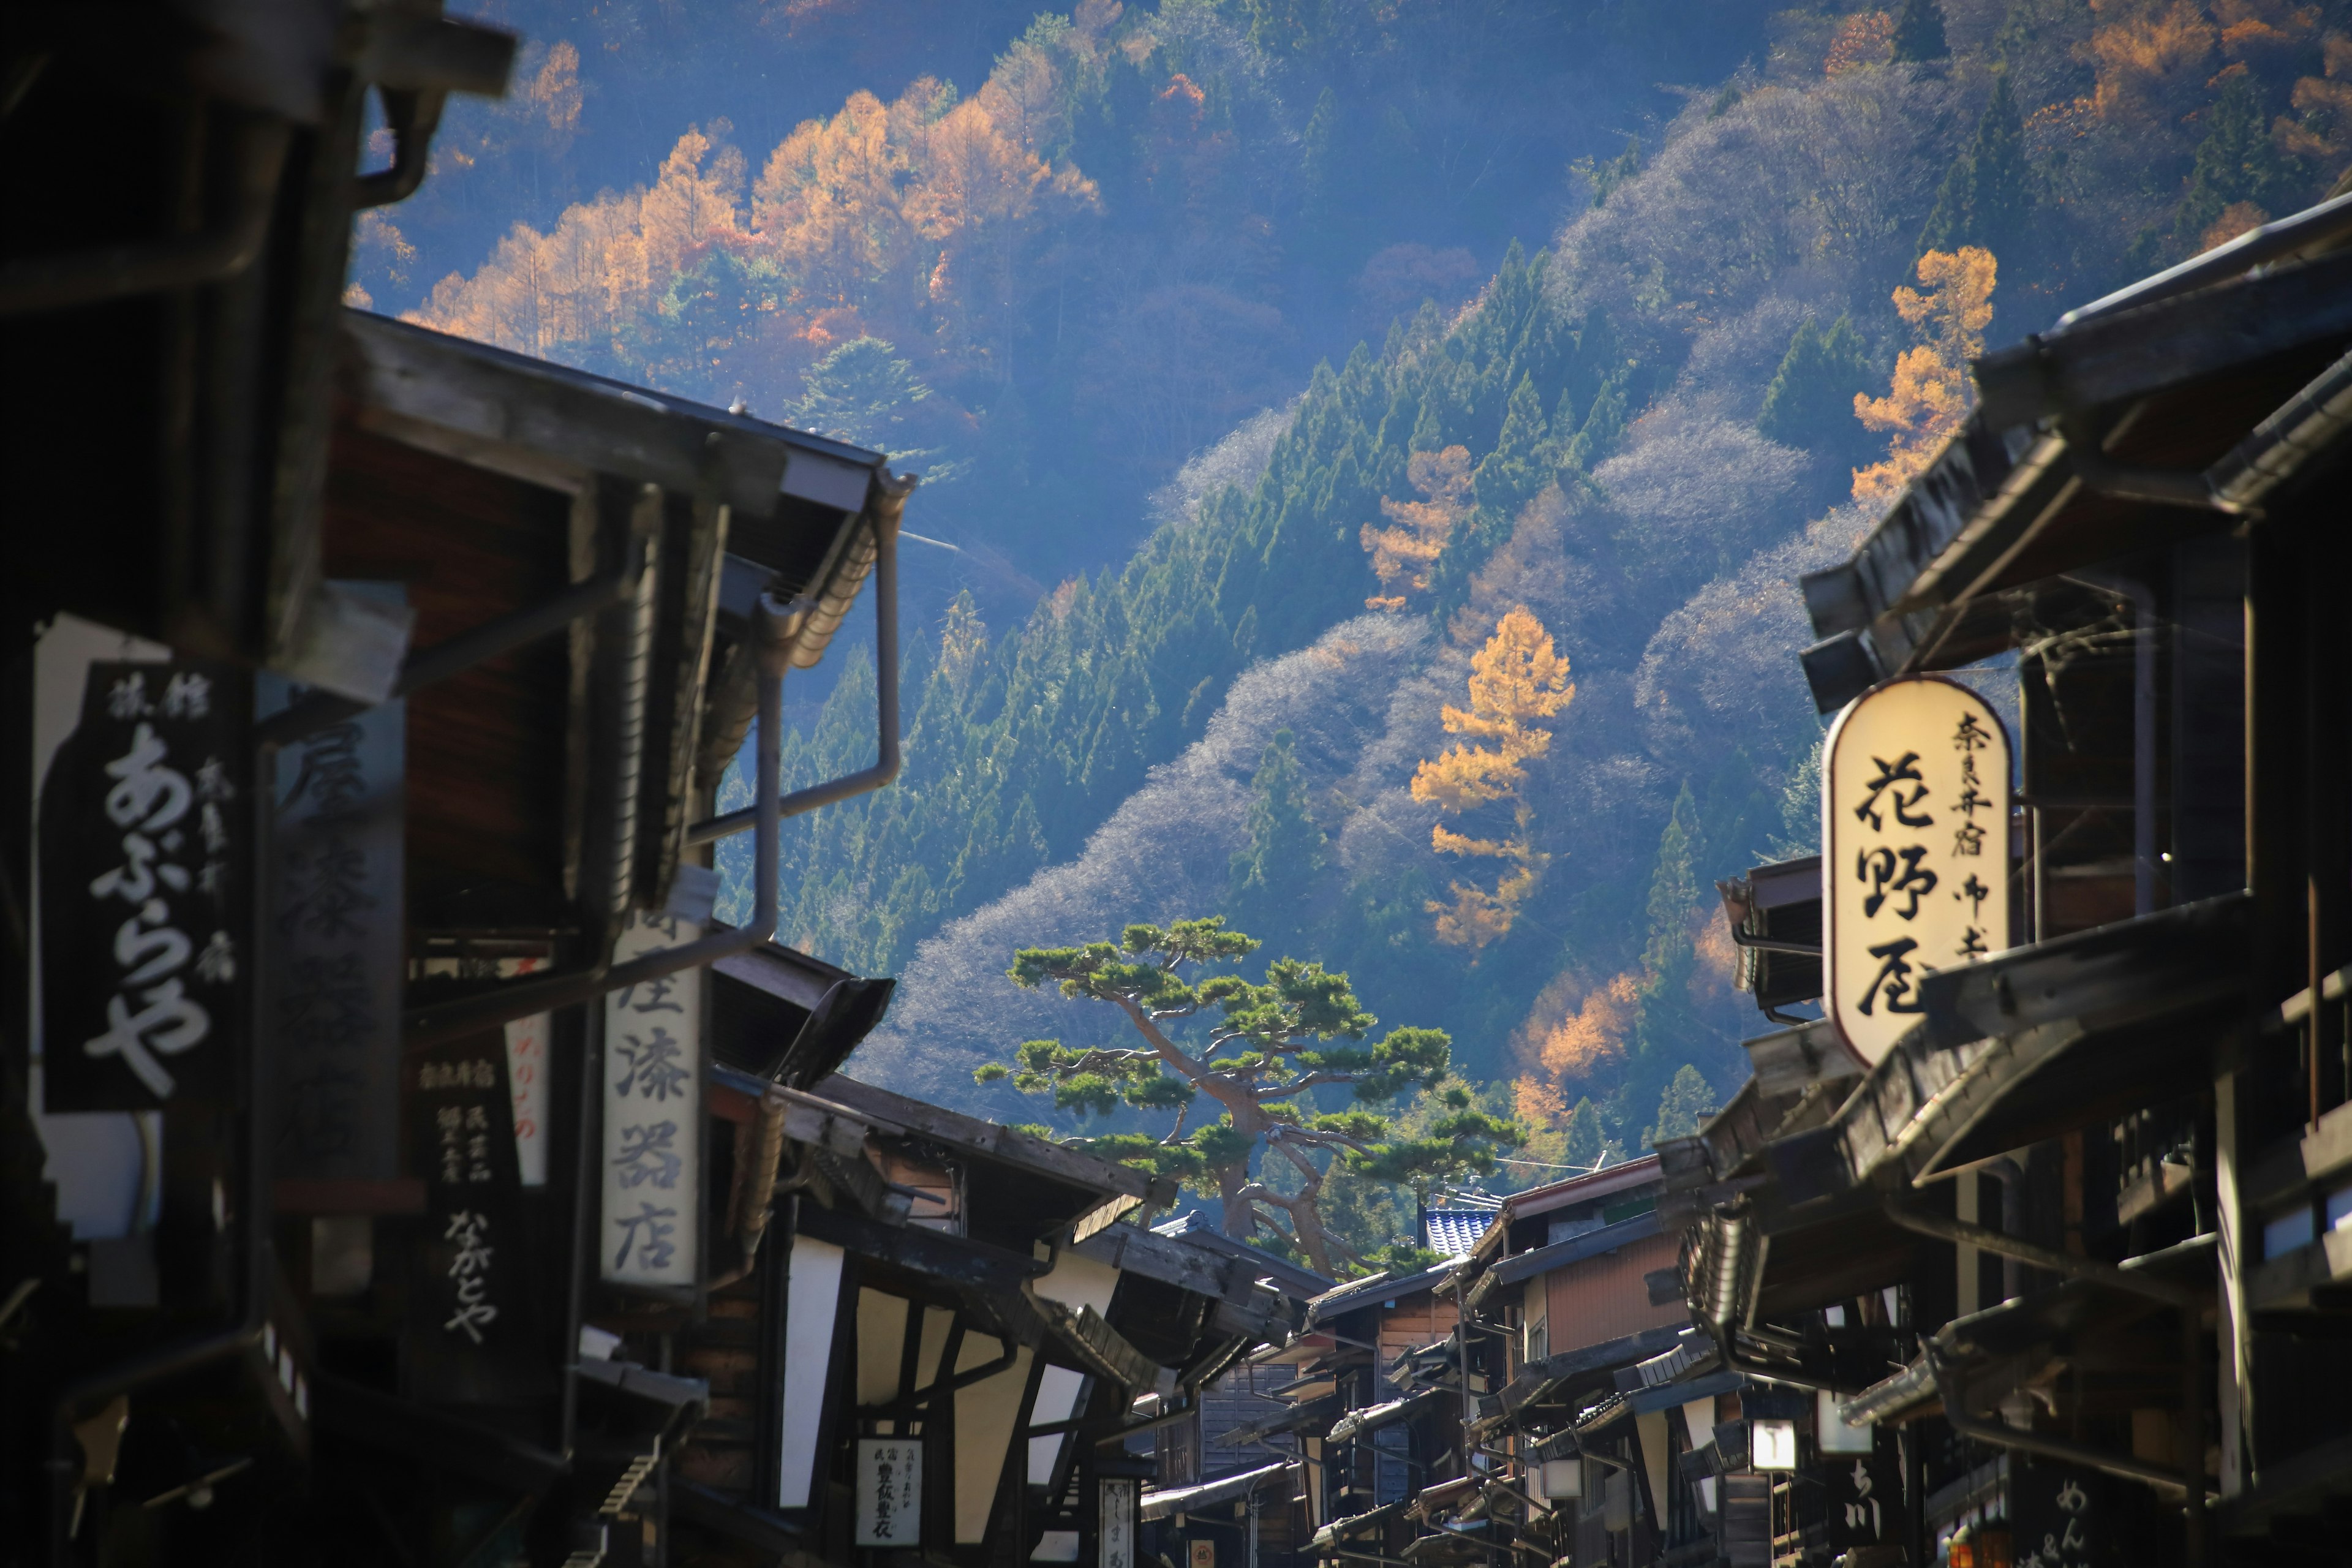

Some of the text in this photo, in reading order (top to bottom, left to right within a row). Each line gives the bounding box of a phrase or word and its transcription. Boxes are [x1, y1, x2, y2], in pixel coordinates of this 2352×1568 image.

[1853, 751, 1939, 1017] 花野屋
[1950, 710, 1991, 858] 奈良井宿
[83, 721, 211, 1101] あぶらや
[276, 682, 378, 1161] 屋漆器店
[445, 1208, 500, 1345] ながとや
[2056, 1477, 2089, 1568] めん
